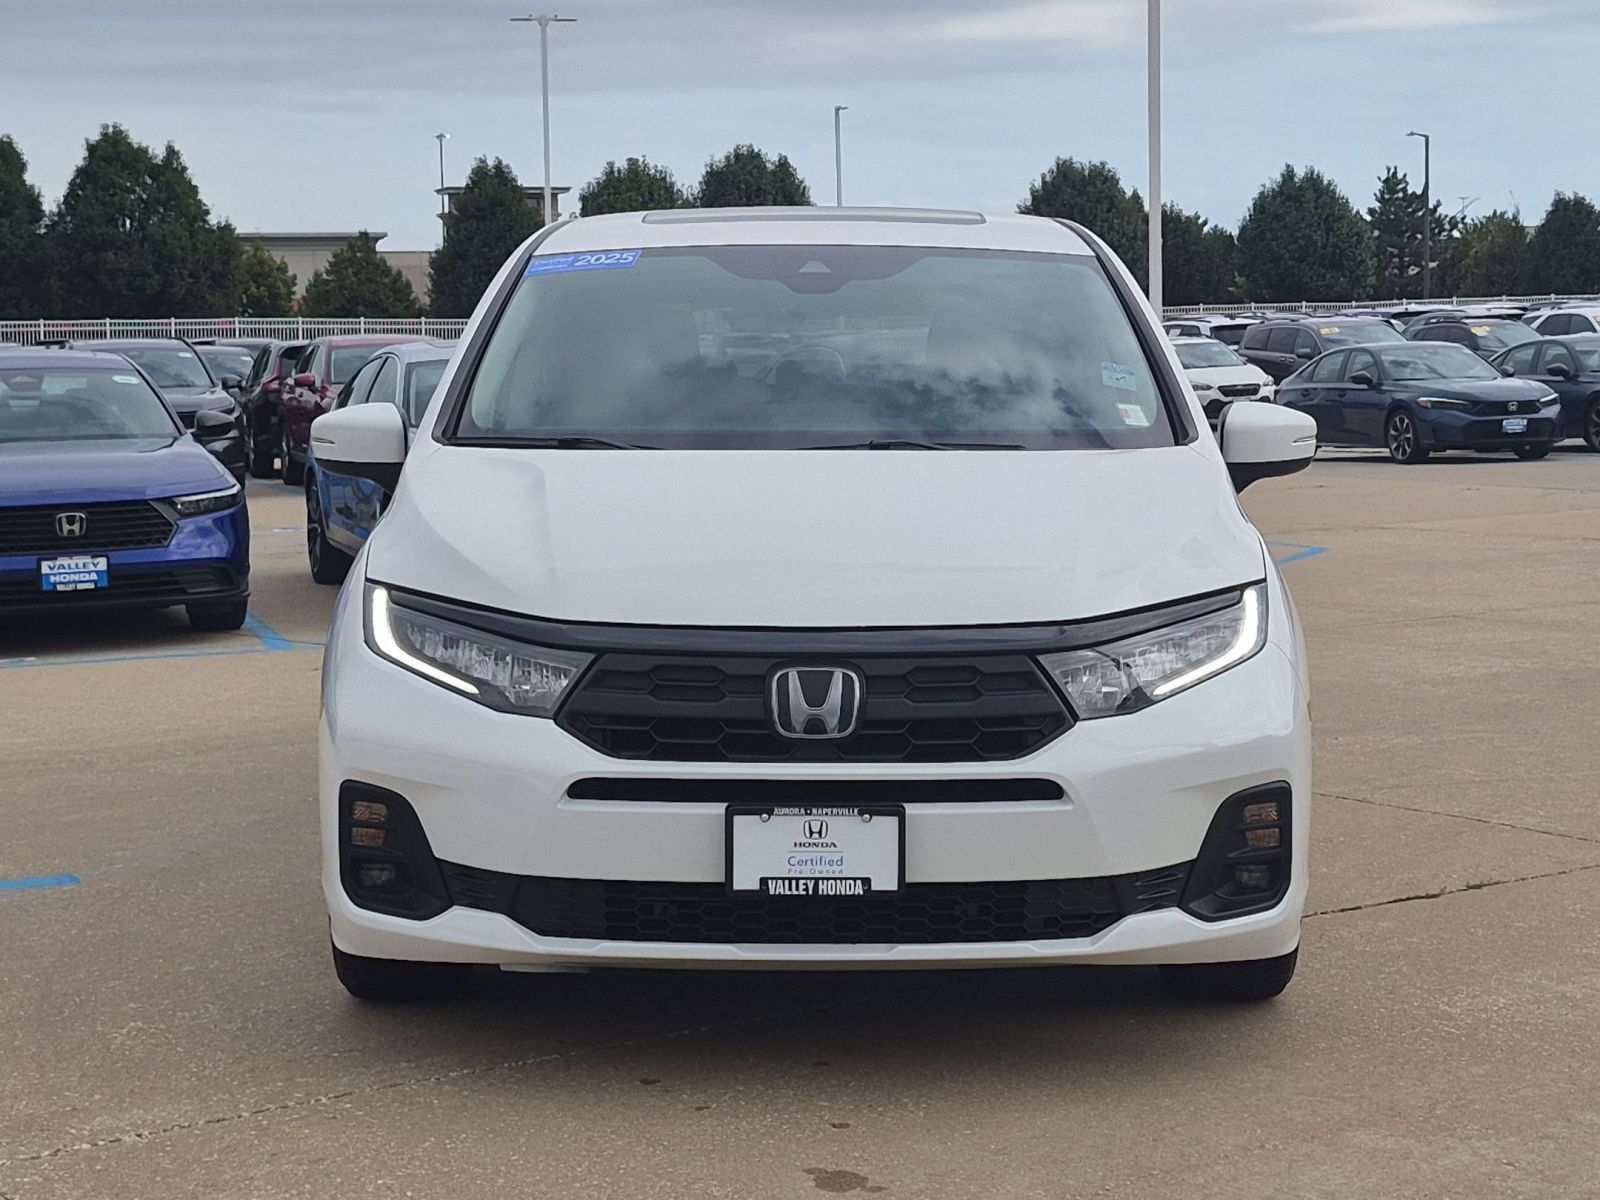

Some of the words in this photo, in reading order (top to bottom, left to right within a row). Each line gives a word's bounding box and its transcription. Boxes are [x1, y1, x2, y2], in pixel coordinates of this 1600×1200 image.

[574, 252, 636, 266] 2025
[47, 561, 100, 571] VALLEY
[50, 572, 98, 583] HONDA
[773, 807, 806, 816] AURORA
[812, 807, 859, 816] NAPERVILLE
[793, 841, 838, 849] HONDA
[787, 855, 844, 867] Certified
[768, 879, 815, 895] VALLEY
[818, 879, 864, 895] HONDA
